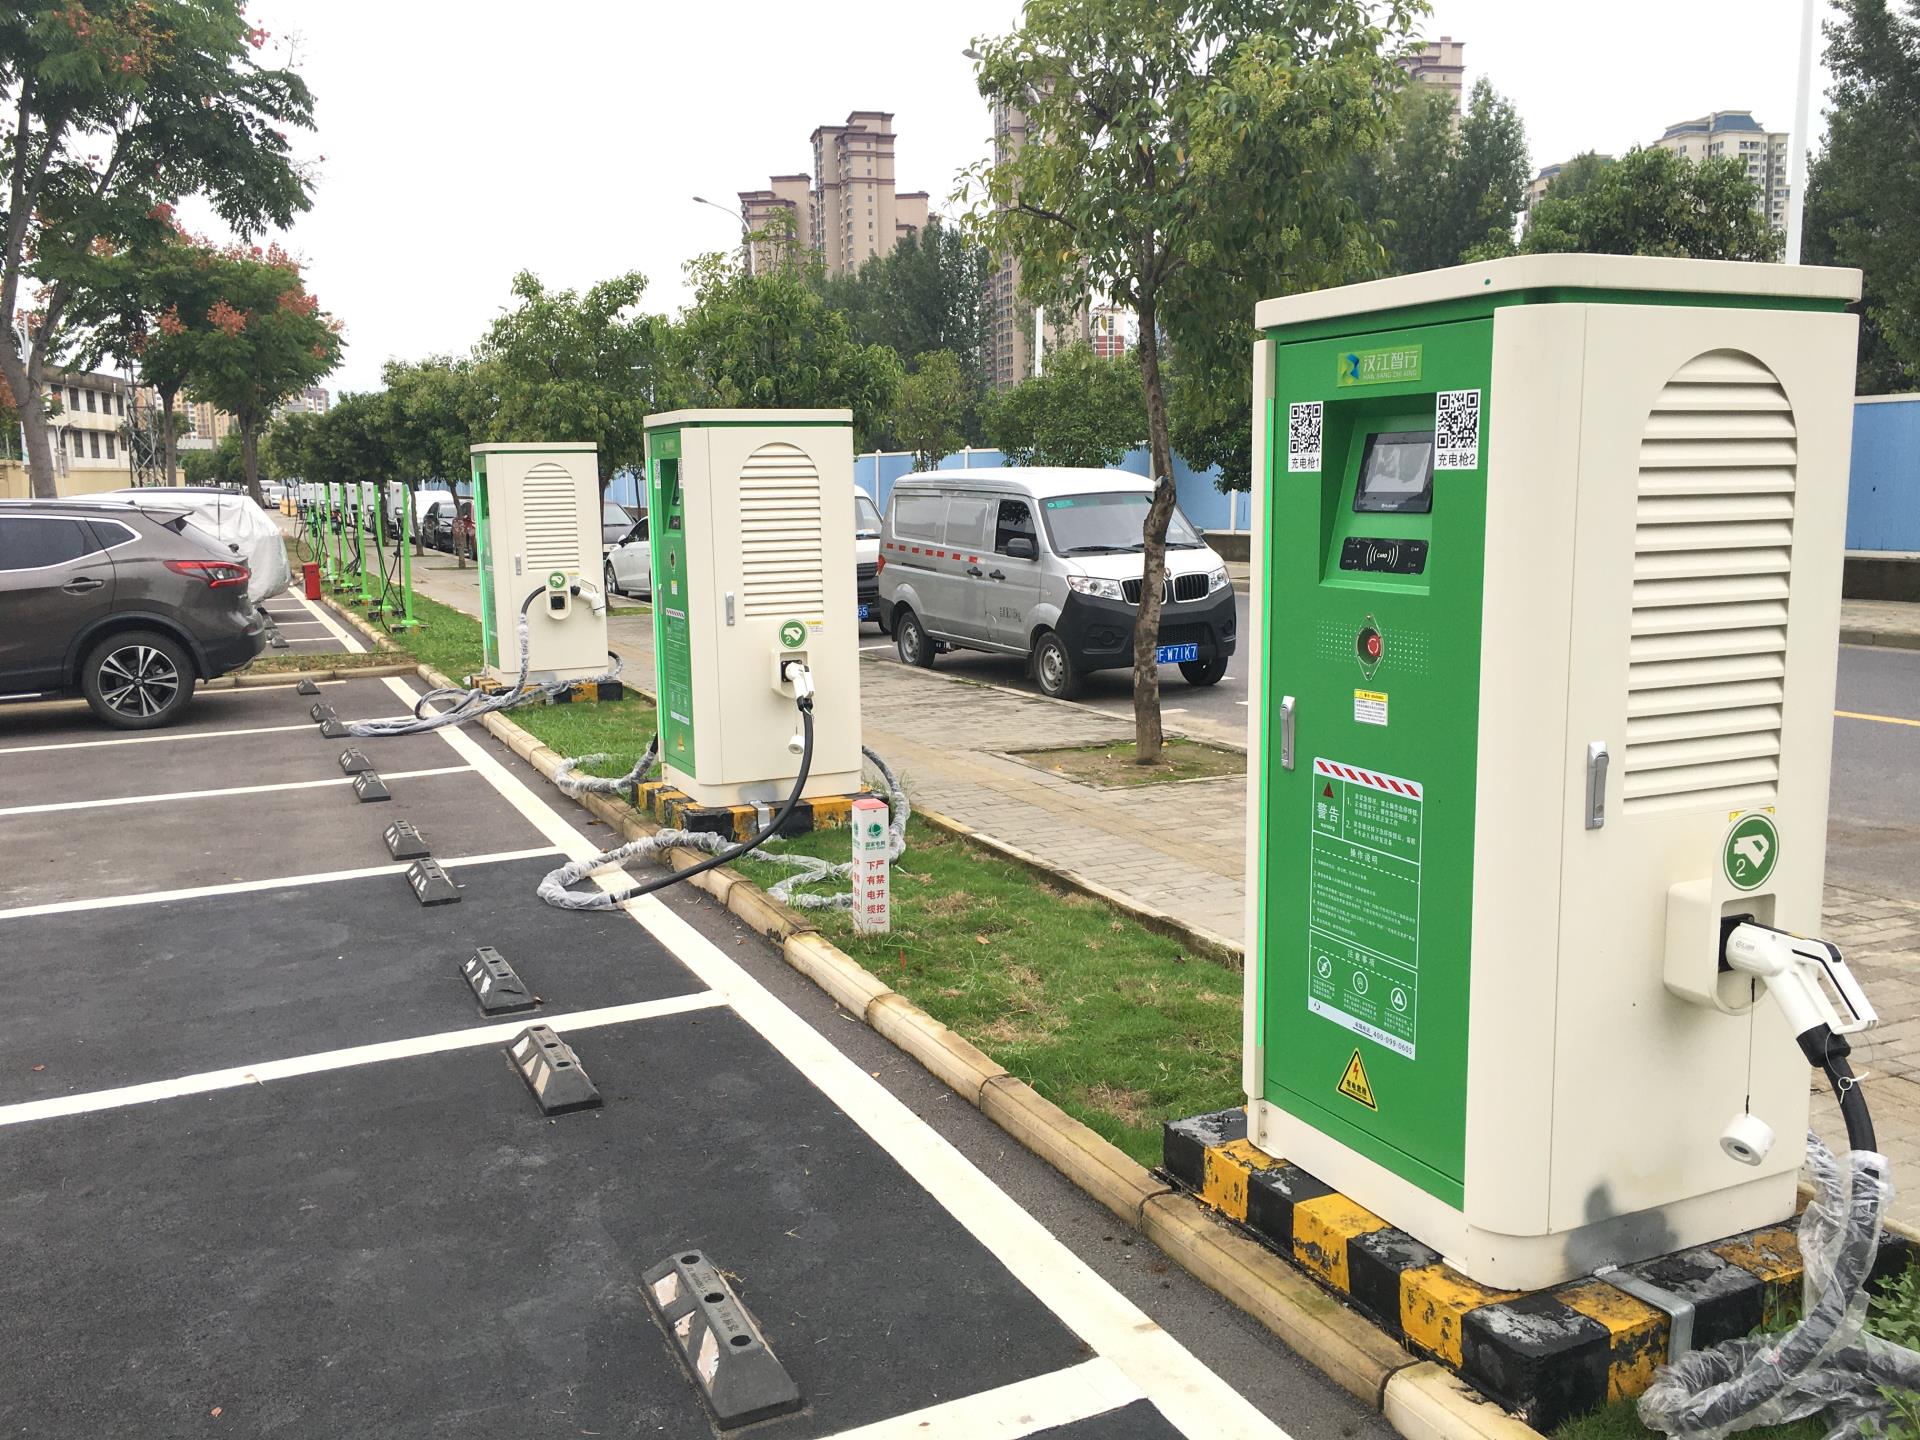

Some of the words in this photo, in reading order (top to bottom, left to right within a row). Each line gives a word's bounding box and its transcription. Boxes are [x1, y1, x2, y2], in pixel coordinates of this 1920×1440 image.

[1363, 351, 1418, 372] 汉江智行
[1291, 457, 1319, 469] 充电枪1
[1438, 453, 1475, 467] 充电枪2
[786, 636, 792, 644] 2
[1316, 801, 1340, 823] 警告
[1350, 847, 1378, 865] 操作说明
[1736, 858, 1746, 877] 2
[866, 860, 875, 914] 下有电缆
[876, 859, 886, 914] 严禁开挖
[1347, 948, 1375, 968] 注意事项
